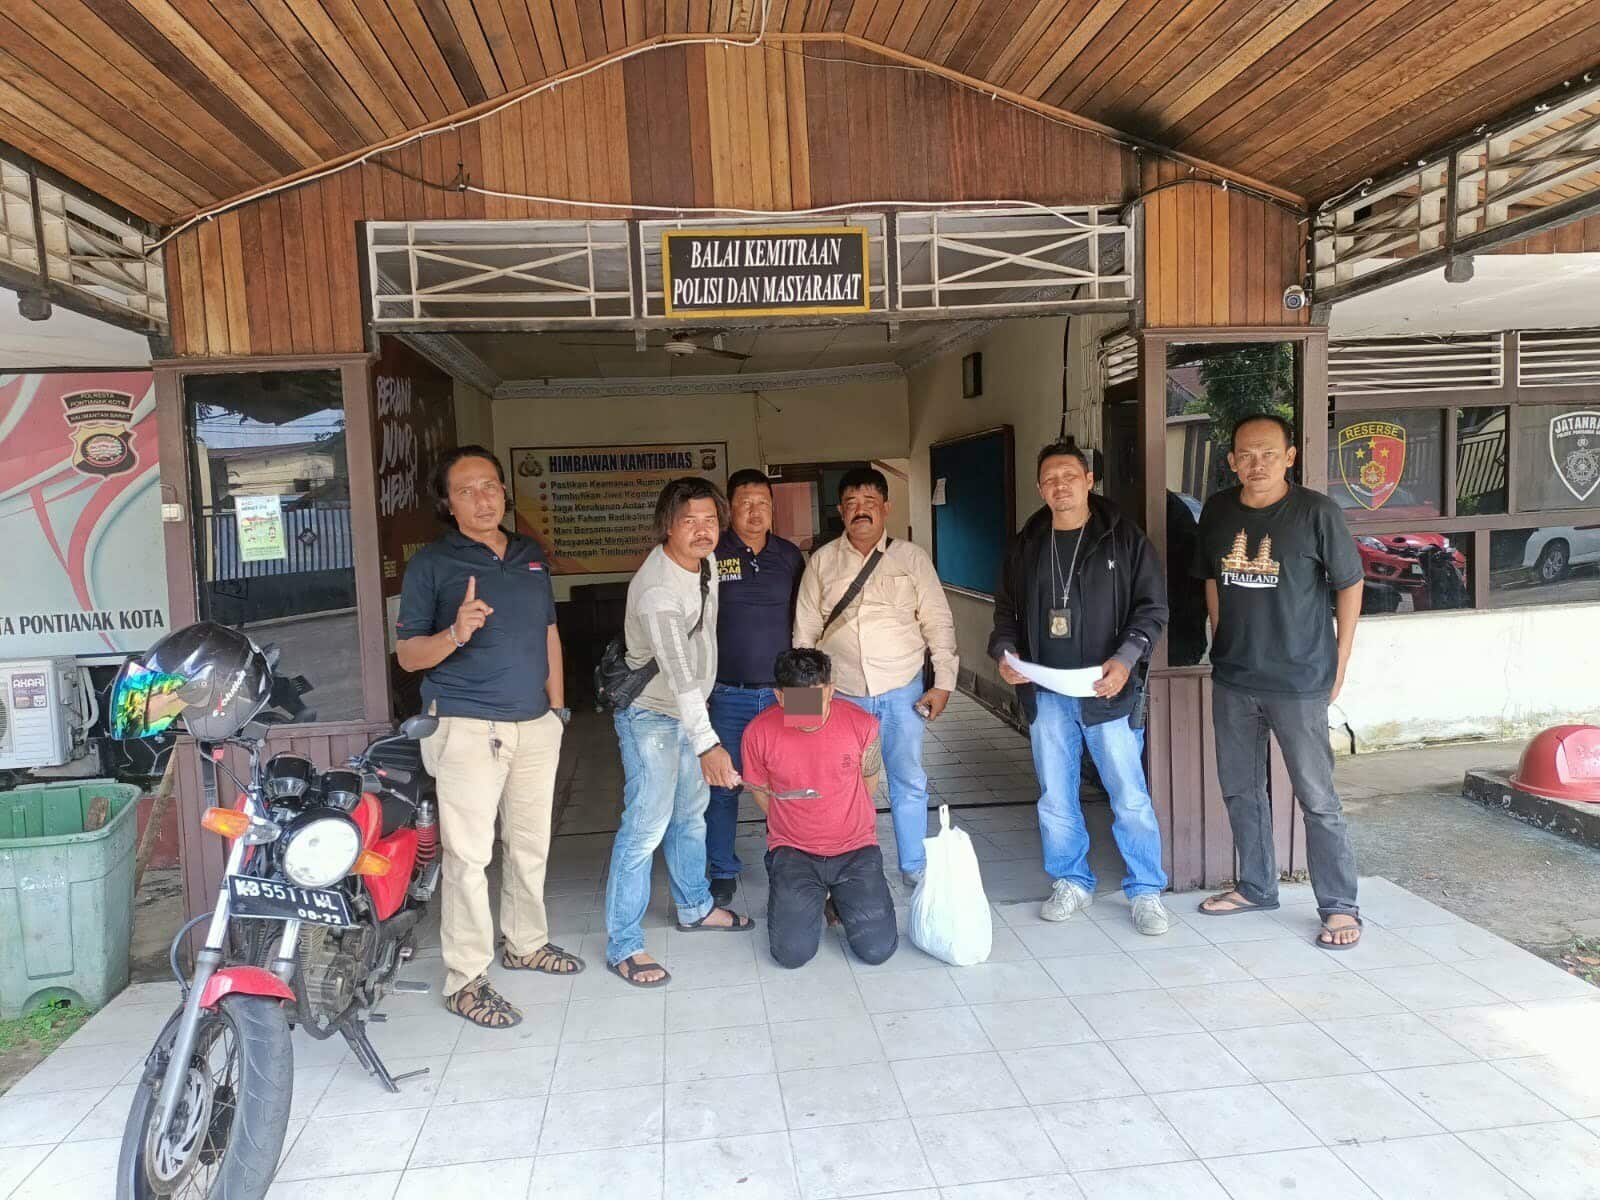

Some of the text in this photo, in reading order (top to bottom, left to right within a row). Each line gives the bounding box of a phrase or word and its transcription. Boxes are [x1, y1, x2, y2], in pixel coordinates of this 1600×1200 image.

[691, 238, 842, 268] BALAI KEMITRAAN
[673, 274, 861, 305] POLISI DAN MASYARAKAT
[1345, 424, 1399, 439] RESERSE
[549, 451, 693, 473] HIMBAWAN KAMTIBMAS
[1221, 571, 1279, 585] THAILAND
[19, 611, 115, 635] PONTIANAK
[119, 608, 165, 630] KOTA
[12, 678, 45, 689] AKARI
